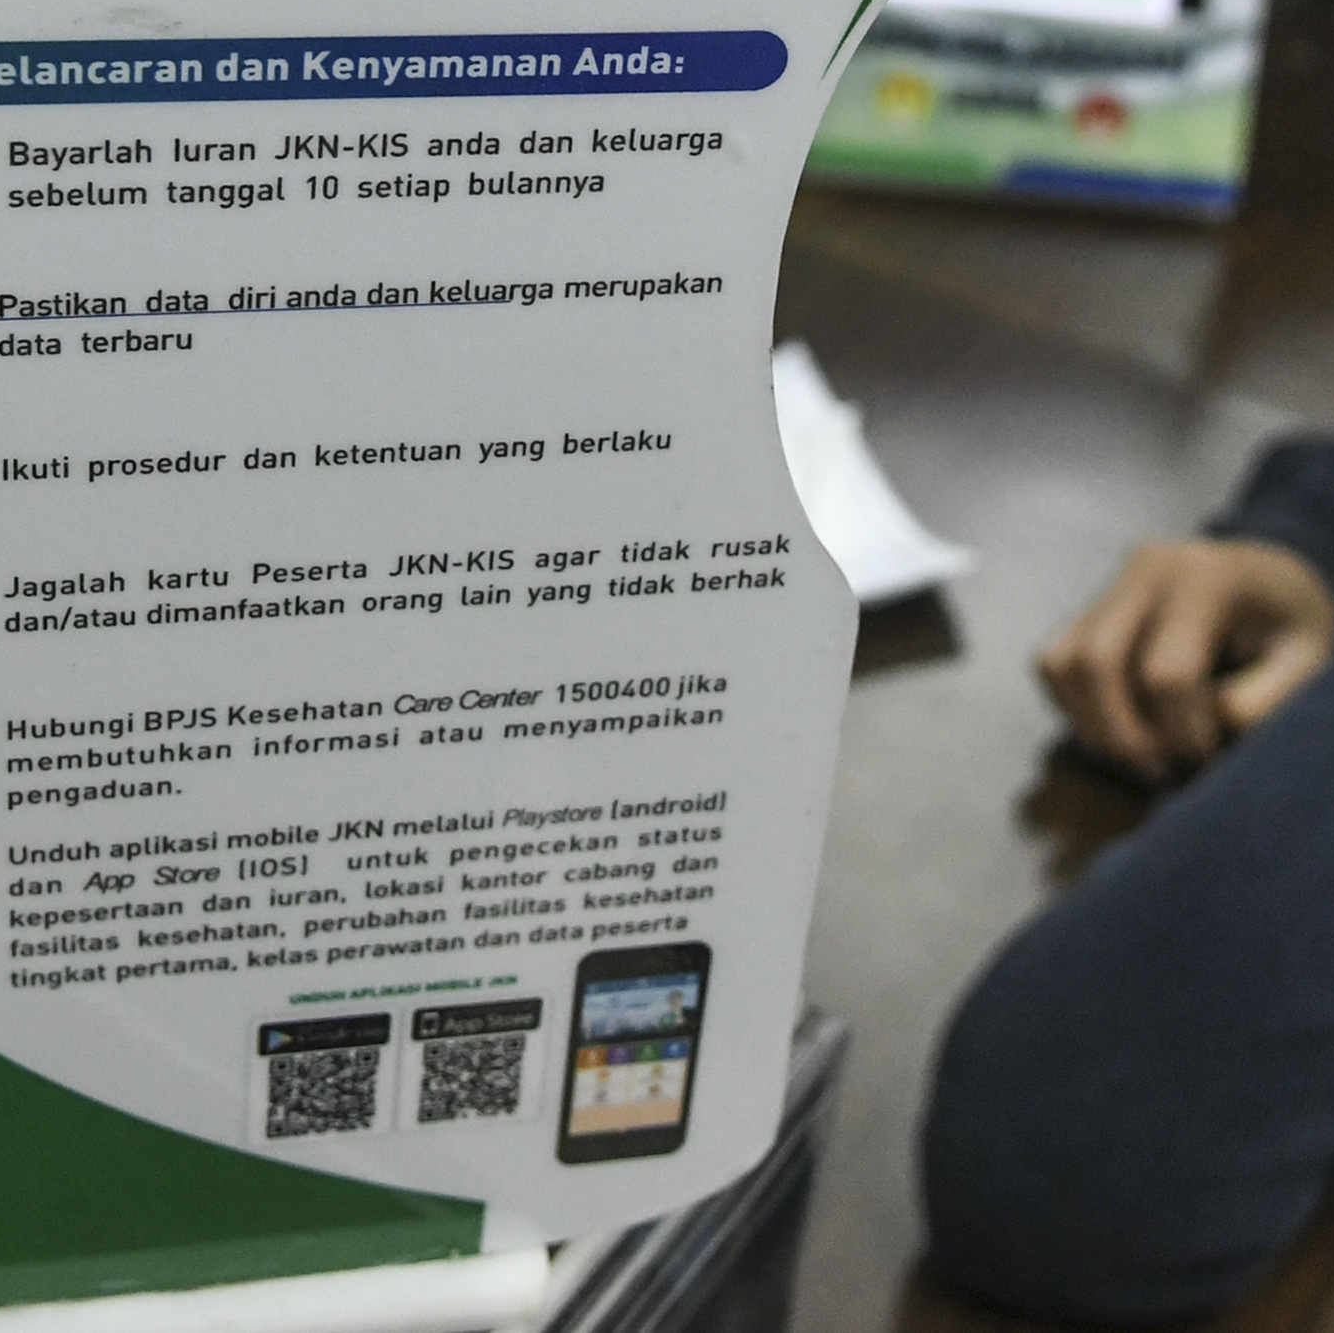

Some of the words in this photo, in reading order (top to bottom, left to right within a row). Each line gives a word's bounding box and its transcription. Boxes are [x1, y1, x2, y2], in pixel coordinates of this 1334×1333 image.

[216, 53, 288, 81] dan
[303, 51, 561, 85] Kenyamanan
[573, 46, 684, 75] Anda:
[9, 139, 152, 171] Bayarlah
[174, 138, 256, 162] Iuran
[274, 133, 409, 160] JKN-KIS
[427, 131, 500, 156] anda
[519, 130, 573, 154] dan
[592, 128, 723, 156] keluarga
[8, 181, 147, 208] sebelum
[166, 177, 285, 209] tanggal
[306, 175, 338, 200] 10
[357, 173, 450, 203] setiap
[468, 171, 604, 199] bulannya
[146, 290, 209, 313] data
[228, 286, 276, 310] diri
[286, 284, 357, 307] anda
[367, 282, 419, 305] dan
[429, 279, 554, 306] keluarga
[564, 272, 723, 301] merupakan
[81, 329, 192, 353] terbaru
[2, 456, 69, 481] Ikuti
[89, 451, 225, 481] prosedur
[243, 448, 296, 470] dan
[315, 442, 461, 467] ketentuan
[479, 440, 545, 464] yang
[563, 429, 671, 455] berlaku
[4, 571, 125, 602] Jagalah
[148, 568, 229, 590] kartu
[253, 560, 367, 584] Peserta
[389, 549, 514, 577] JKN-KIS
[535, 550, 601, 573] agar
[621, 540, 690, 563] tidak
[711, 534, 790, 558] rusak
[4, 606, 136, 633] dan/atau
[146, 595, 344, 624] dimanfaatkan
[362, 593, 443, 614] orang
[461, 584, 511, 606] lain
[527, 584, 591, 607] yang
[608, 574, 675, 597] tidak
[691, 567, 785, 592] berhak
[6, 712, 134, 742] Hubungi
[143, 706, 218, 733] BPJS
[226, 699, 384, 727] Kesehatan
[393, 693, 454, 716] Care
[458, 687, 543, 711] Center
[556, 675, 672, 705] 1500400
[674, 673, 728, 702] jika
[6, 741, 232, 775] membutuhkan
[253, 726, 400, 757] informasi
[418, 725, 484, 746] atau
[503, 707, 724, 740] menyampaikan
[6, 778, 183, 812] pengaduan.
[7, 840, 101, 867] Unduh
[108, 830, 219, 863] aplikasi
[226, 824, 320, 850] mobile
[327, 818, 385, 843] JKN
[391, 809, 495, 838] melalui
[8, 877, 63, 898] dan
[82, 871, 136, 896] App
[152, 865, 222, 887] Store
[346, 846, 429, 872] untuk
[448, 834, 619, 868] pengecekan
[637, 826, 723, 848] status
[8, 900, 184, 931] kepesertaan
[201, 892, 252, 914] dan
[364, 874, 445, 900] lokasi
[460, 870, 548, 892] kantor
[563, 861, 656, 884] cabang
[671, 854, 719, 875] dan
[9, 934, 121, 960] fasilitas
[303, 907, 447, 940] perubahan
[463, 897, 567, 921] fasilitas
[582, 884, 715, 910] kesehatan
[9, 963, 107, 991] tingkat
[246, 947, 320, 969] kelas
[325, 936, 466, 966] perawatan
[473, 929, 521, 950] dan
[528, 925, 585, 945] data
[590, 915, 689, 942] peserta
